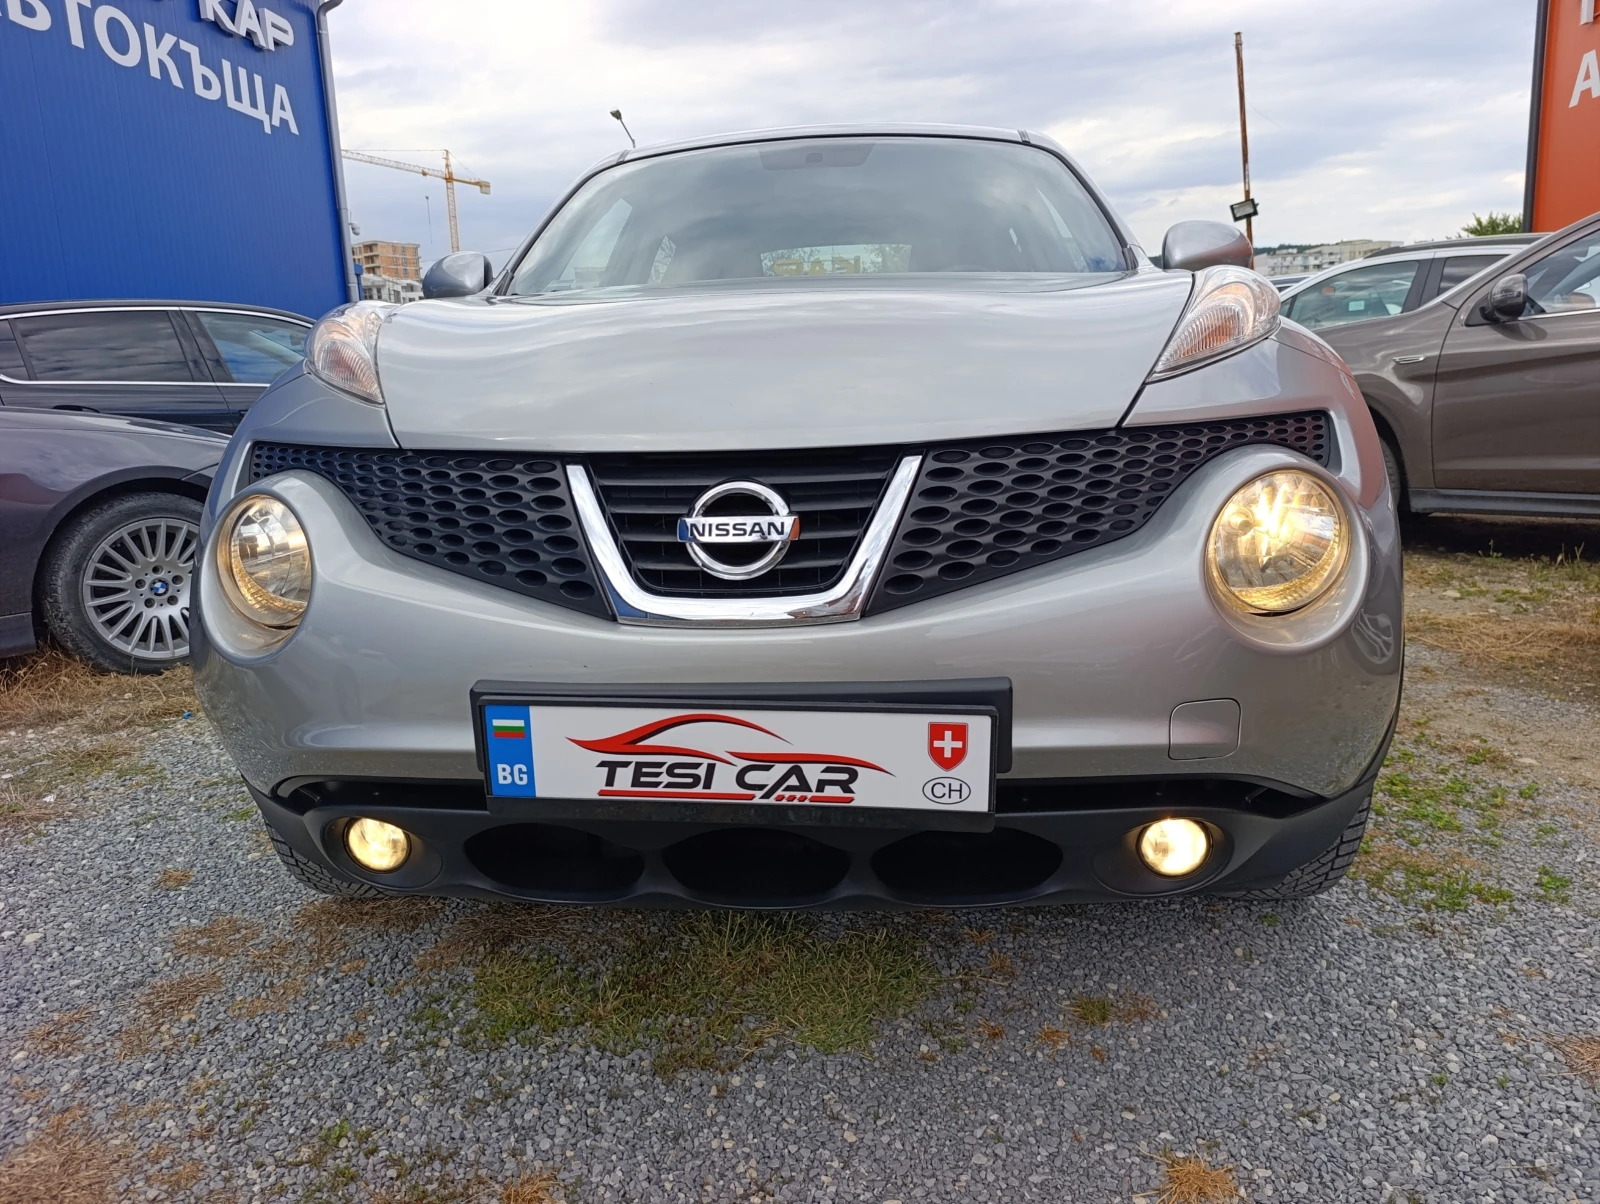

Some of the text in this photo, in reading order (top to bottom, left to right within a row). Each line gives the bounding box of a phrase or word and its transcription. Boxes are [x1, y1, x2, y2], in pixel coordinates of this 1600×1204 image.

[0, 0, 299, 135] ТОКЪЩА
[689, 521, 785, 538] NISSAN
[496, 763, 528, 786] BG
[596, 760, 860, 800] TESI CAR
[931, 782, 963, 800] CH
